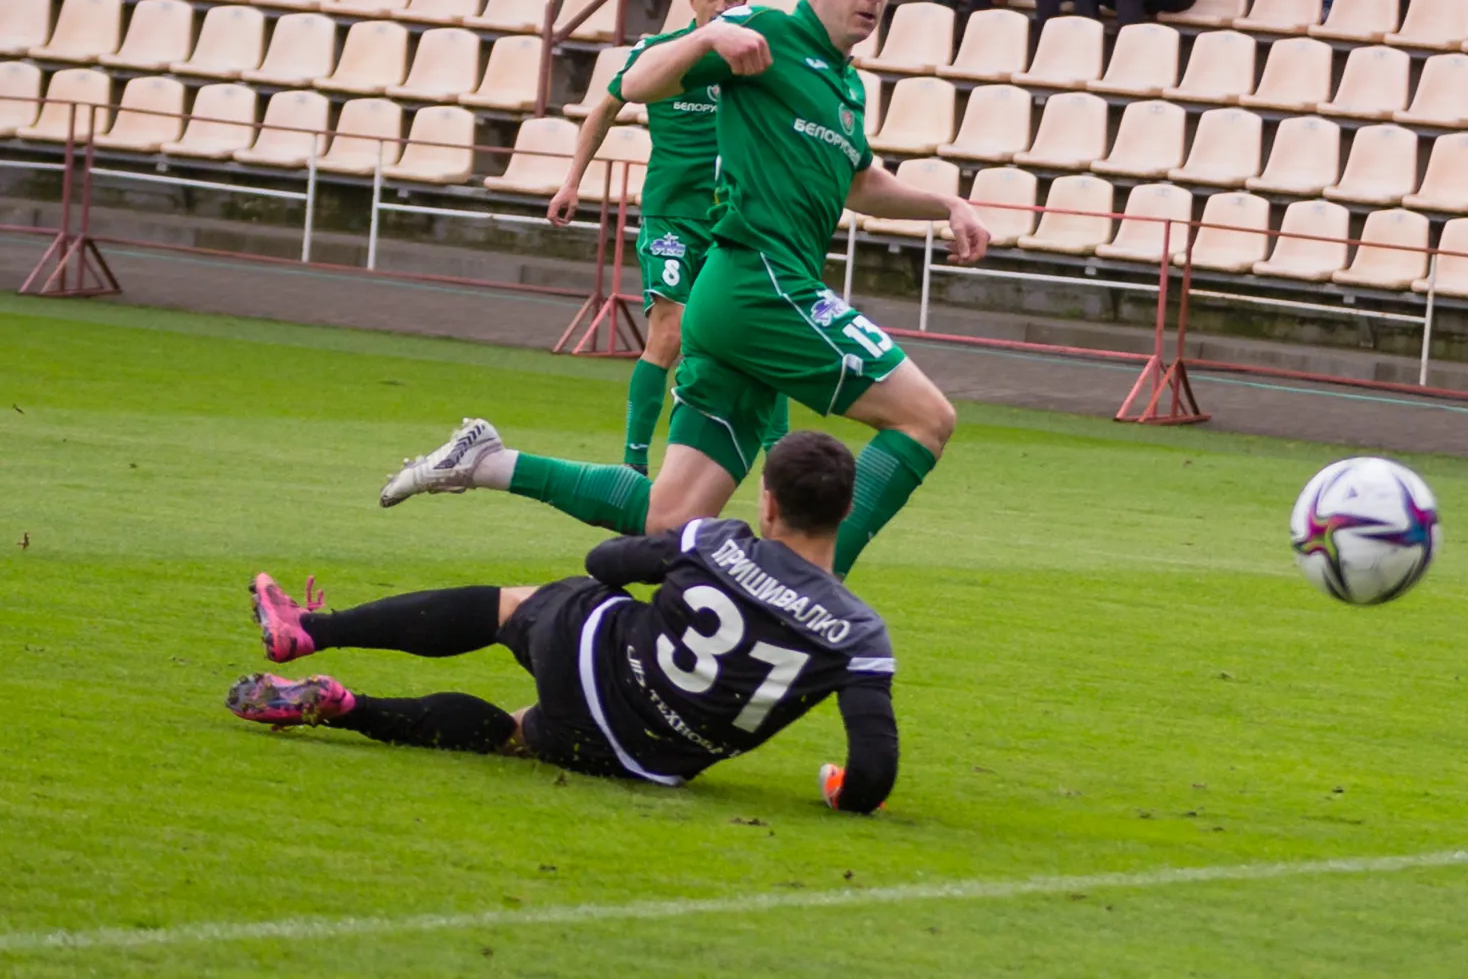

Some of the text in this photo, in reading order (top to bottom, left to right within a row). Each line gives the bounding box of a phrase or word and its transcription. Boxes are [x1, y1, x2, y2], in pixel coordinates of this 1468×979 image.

[662, 259, 680, 286] 8
[711, 539, 851, 643] ПРИШИВАЛКО
[657, 586, 810, 733] 37
